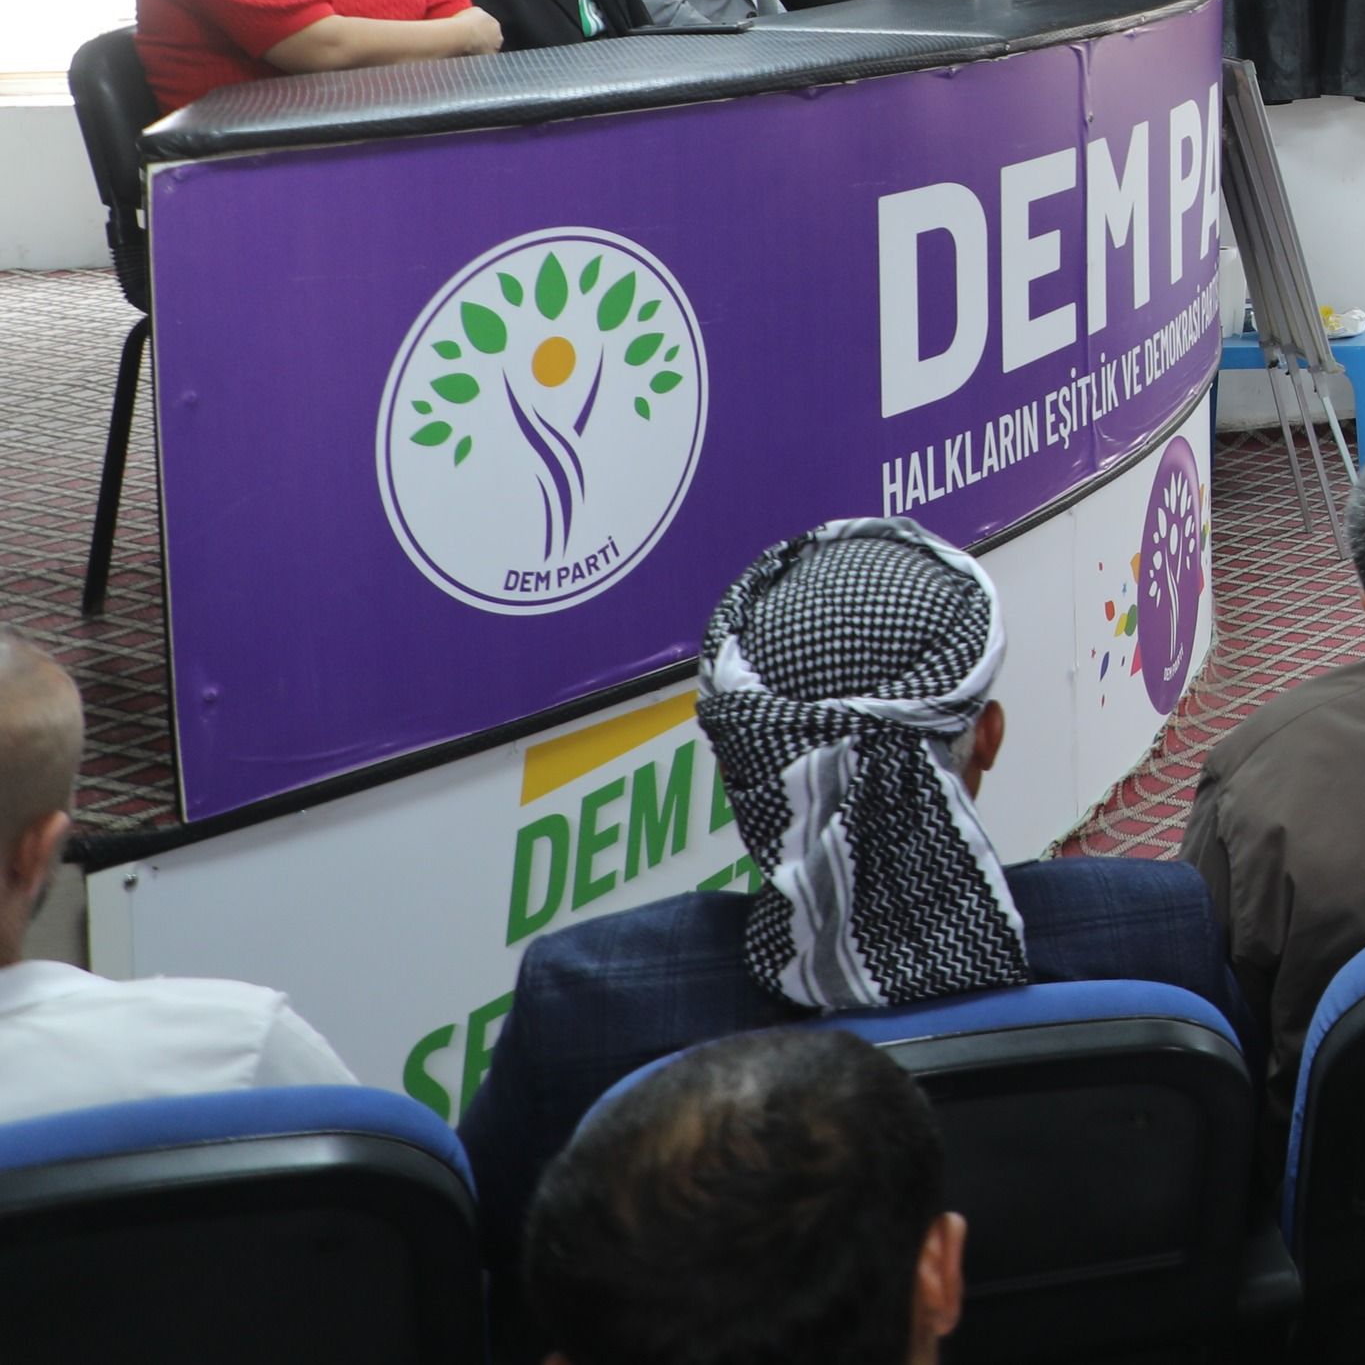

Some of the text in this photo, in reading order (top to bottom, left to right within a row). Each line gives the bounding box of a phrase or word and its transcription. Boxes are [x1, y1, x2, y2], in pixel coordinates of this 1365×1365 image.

[878, 120, 1151, 419] DEM
[882, 400, 1039, 518] HALKLARIN
[1046, 352, 1120, 450] EŞİTLİK
[1121, 344, 1143, 401] VE
[1144, 284, 1201, 387] DEMOKRASİ
[503, 535, 620, 593] DEM PARTİ
[505, 738, 696, 949] DEM
